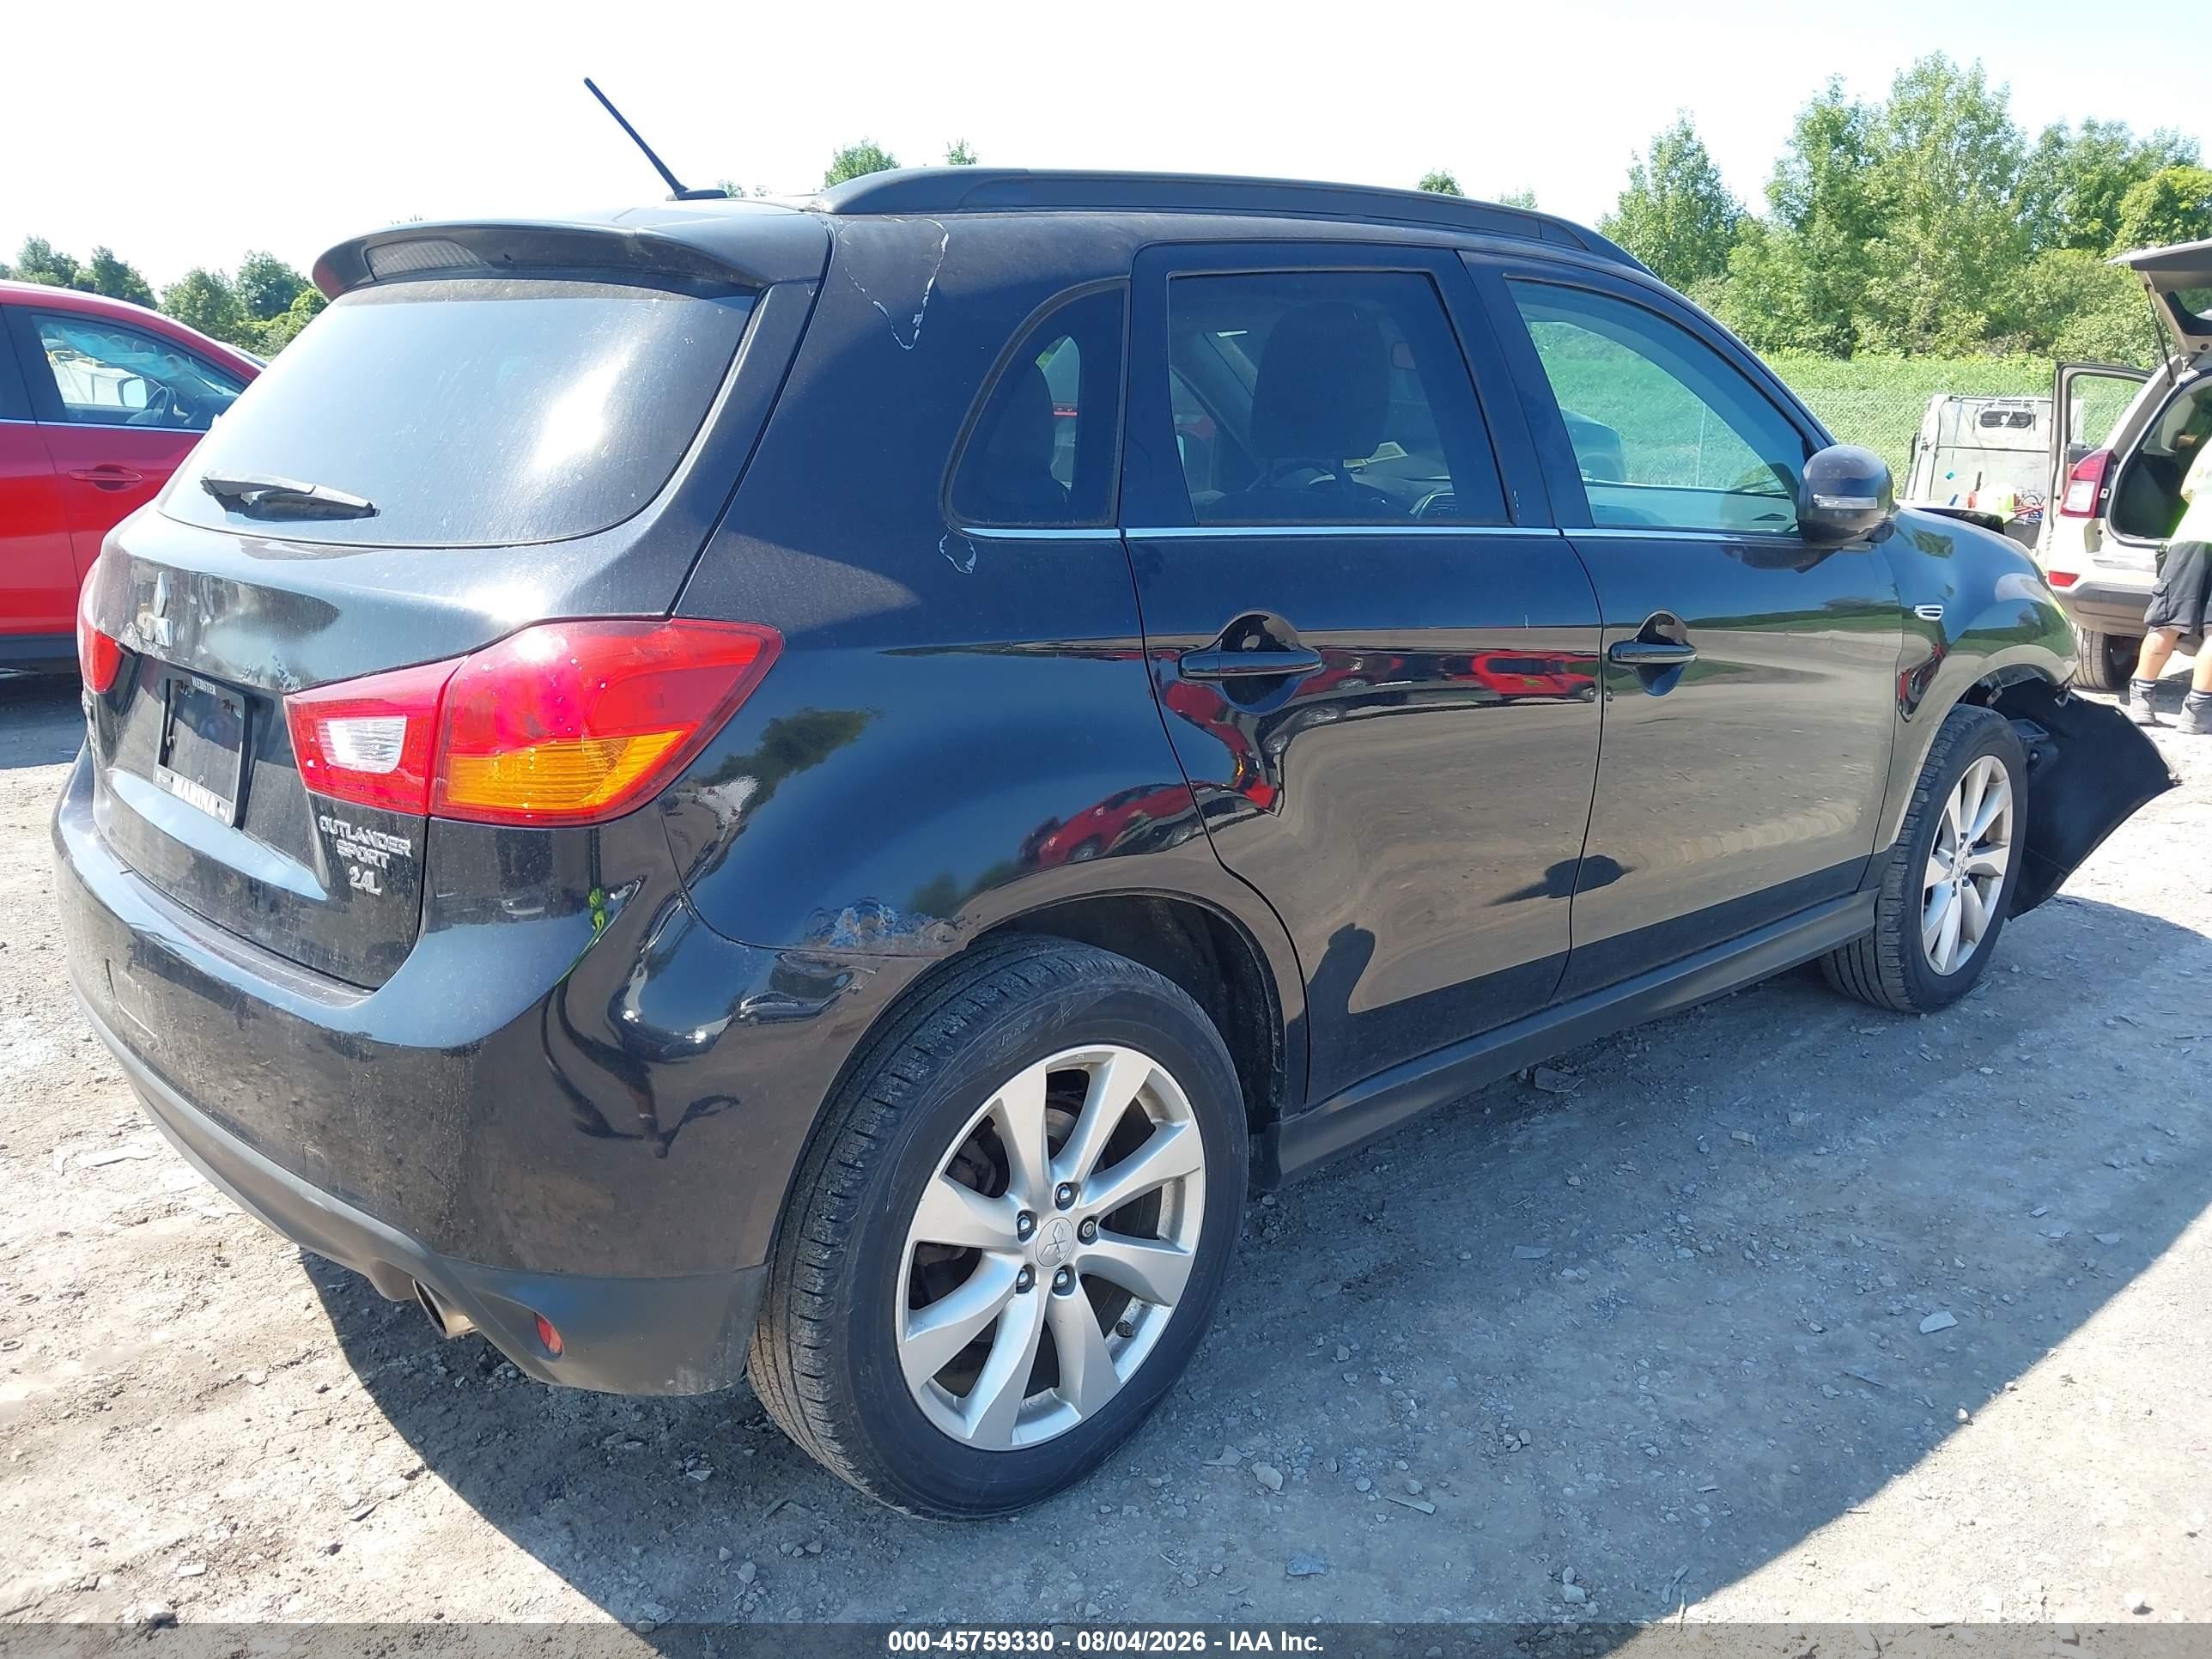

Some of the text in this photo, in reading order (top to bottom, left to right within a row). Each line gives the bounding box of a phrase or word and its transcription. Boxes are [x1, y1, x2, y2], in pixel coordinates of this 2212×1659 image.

[191, 675, 217, 696] WEBSTER
[318, 815, 412, 857] OUTLANDER
[336, 838, 390, 869] SPORT
